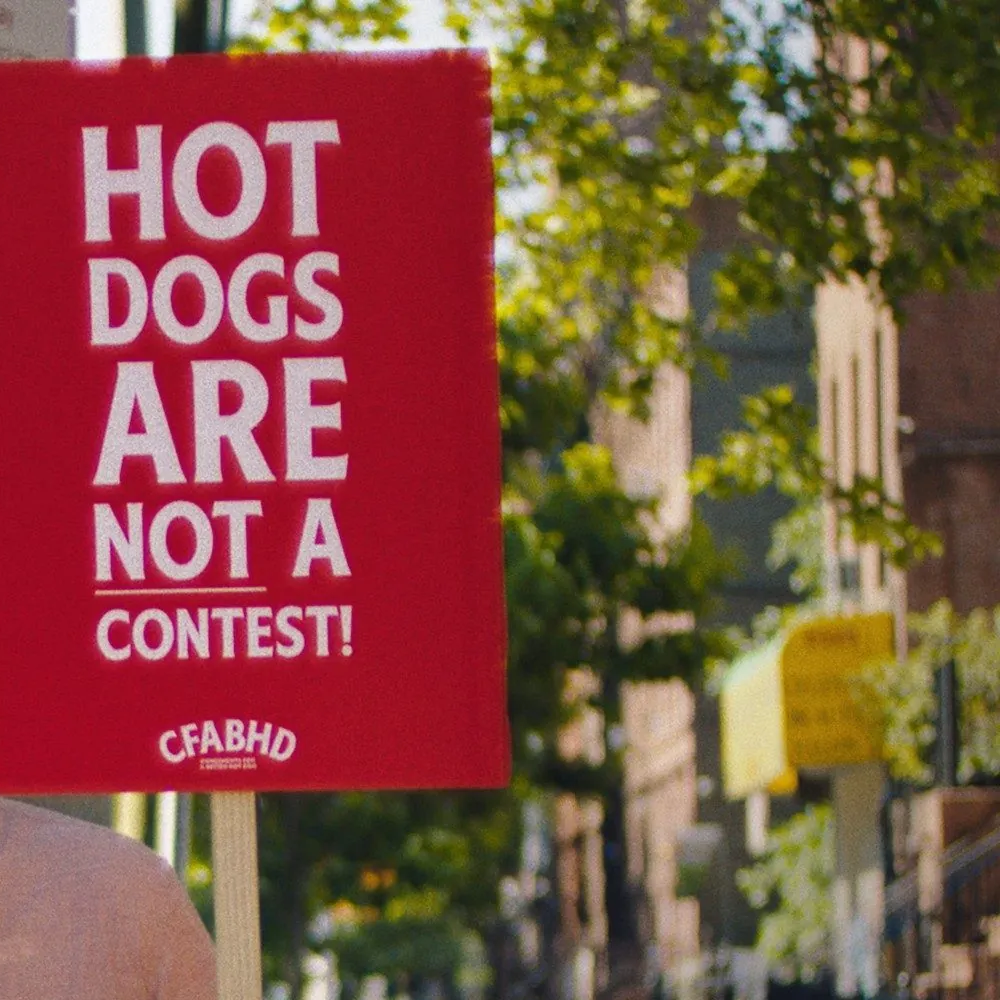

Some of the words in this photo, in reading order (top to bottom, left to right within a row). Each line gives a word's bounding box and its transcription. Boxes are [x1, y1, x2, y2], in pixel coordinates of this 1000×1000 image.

[82, 120, 341, 242] HOT
[88, 252, 344, 346] DOGS
[93, 357, 349, 485] ARE
[94, 500, 263, 582] NOT
[292, 499, 352, 578] A
[97, 605, 353, 662] CONTEST!
[158, 718, 297, 763] CFABHD
